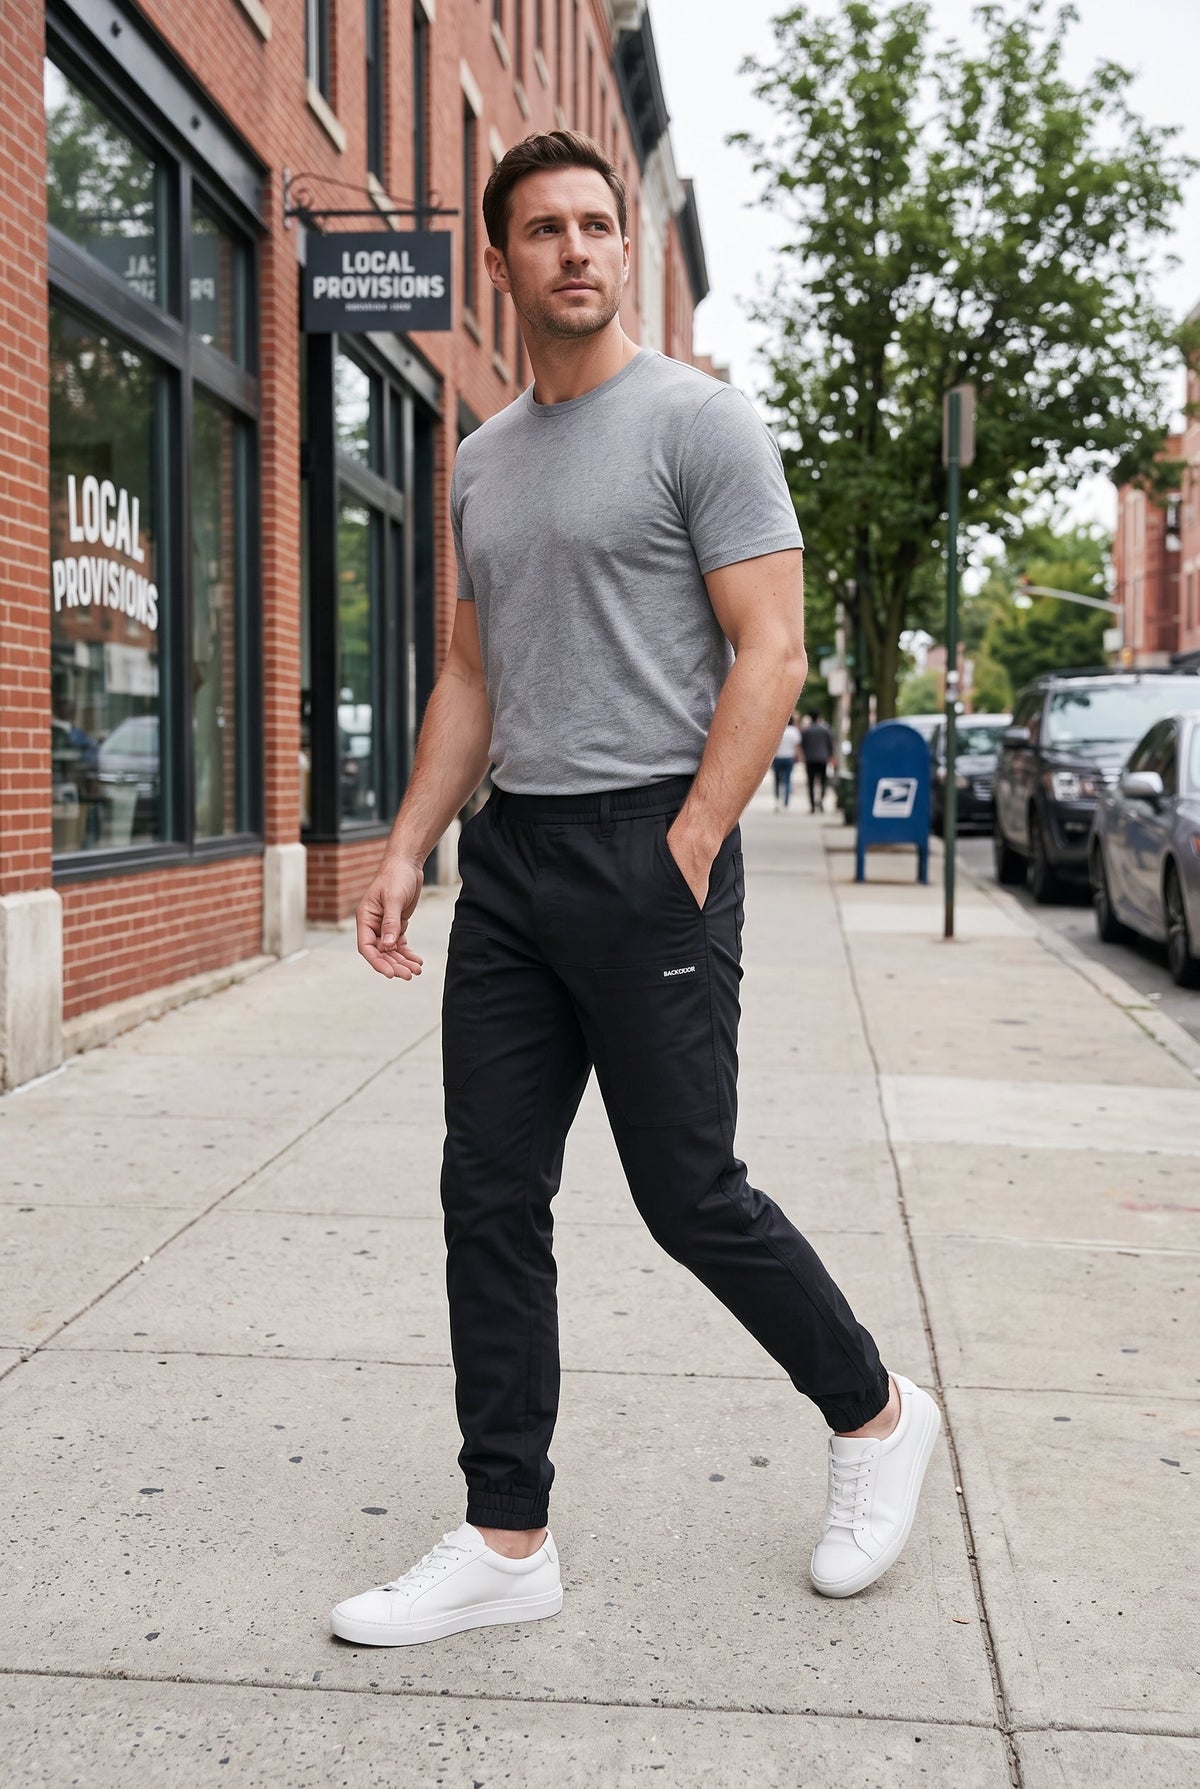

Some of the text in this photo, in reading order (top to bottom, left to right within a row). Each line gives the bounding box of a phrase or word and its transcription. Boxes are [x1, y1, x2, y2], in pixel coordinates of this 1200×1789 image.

[313, 275, 445, 299] PROVISIONS
[342, 250, 415, 274] LOCAL
[67, 474, 145, 564] LOCAL
[52, 555, 158, 631] PROVISIONS
